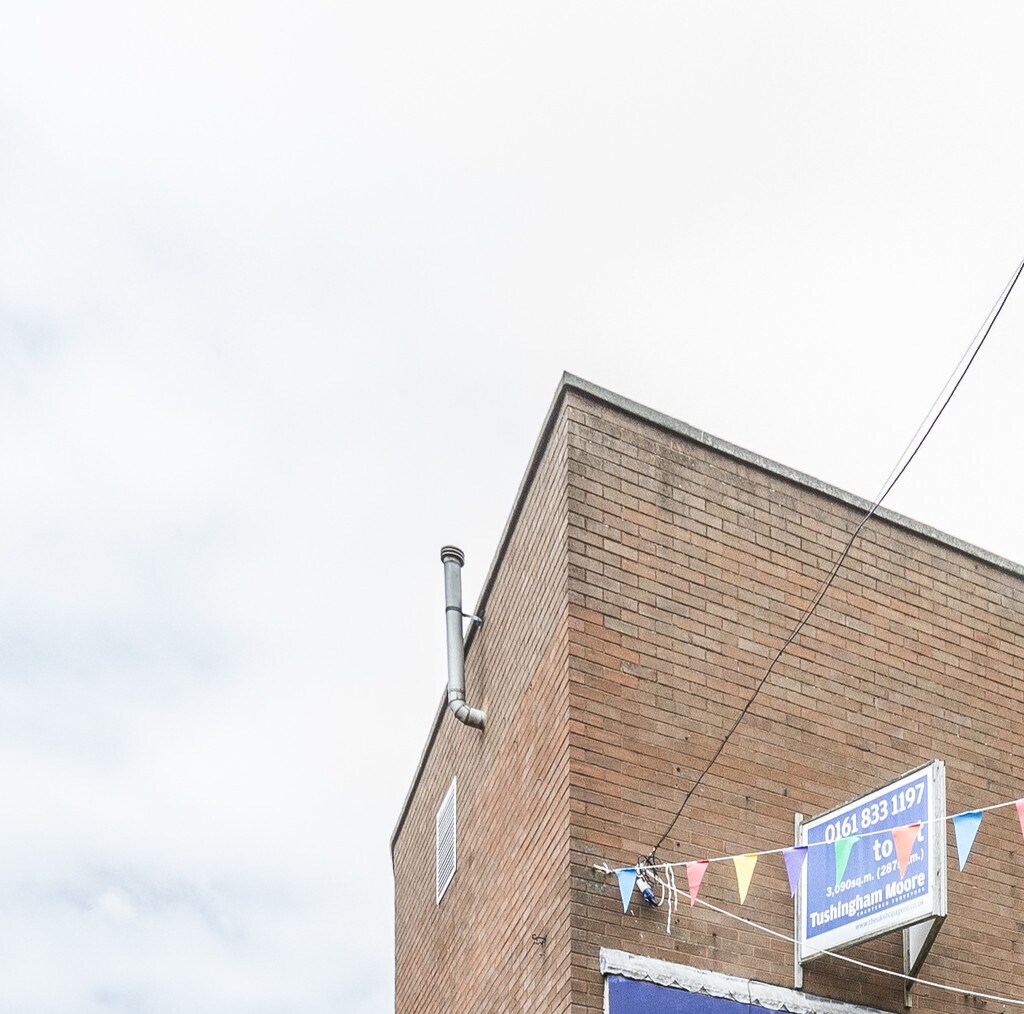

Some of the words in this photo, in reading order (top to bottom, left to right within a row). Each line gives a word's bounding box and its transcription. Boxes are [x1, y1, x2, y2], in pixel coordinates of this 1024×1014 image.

[825, 812, 858, 844] 0161
[861, 800, 889, 830] 833
[892, 782, 925, 815] 1197
[873, 838, 893, 862] to
[809, 888, 883, 928] Tushingham
[885, 872, 925, 900] Moore
